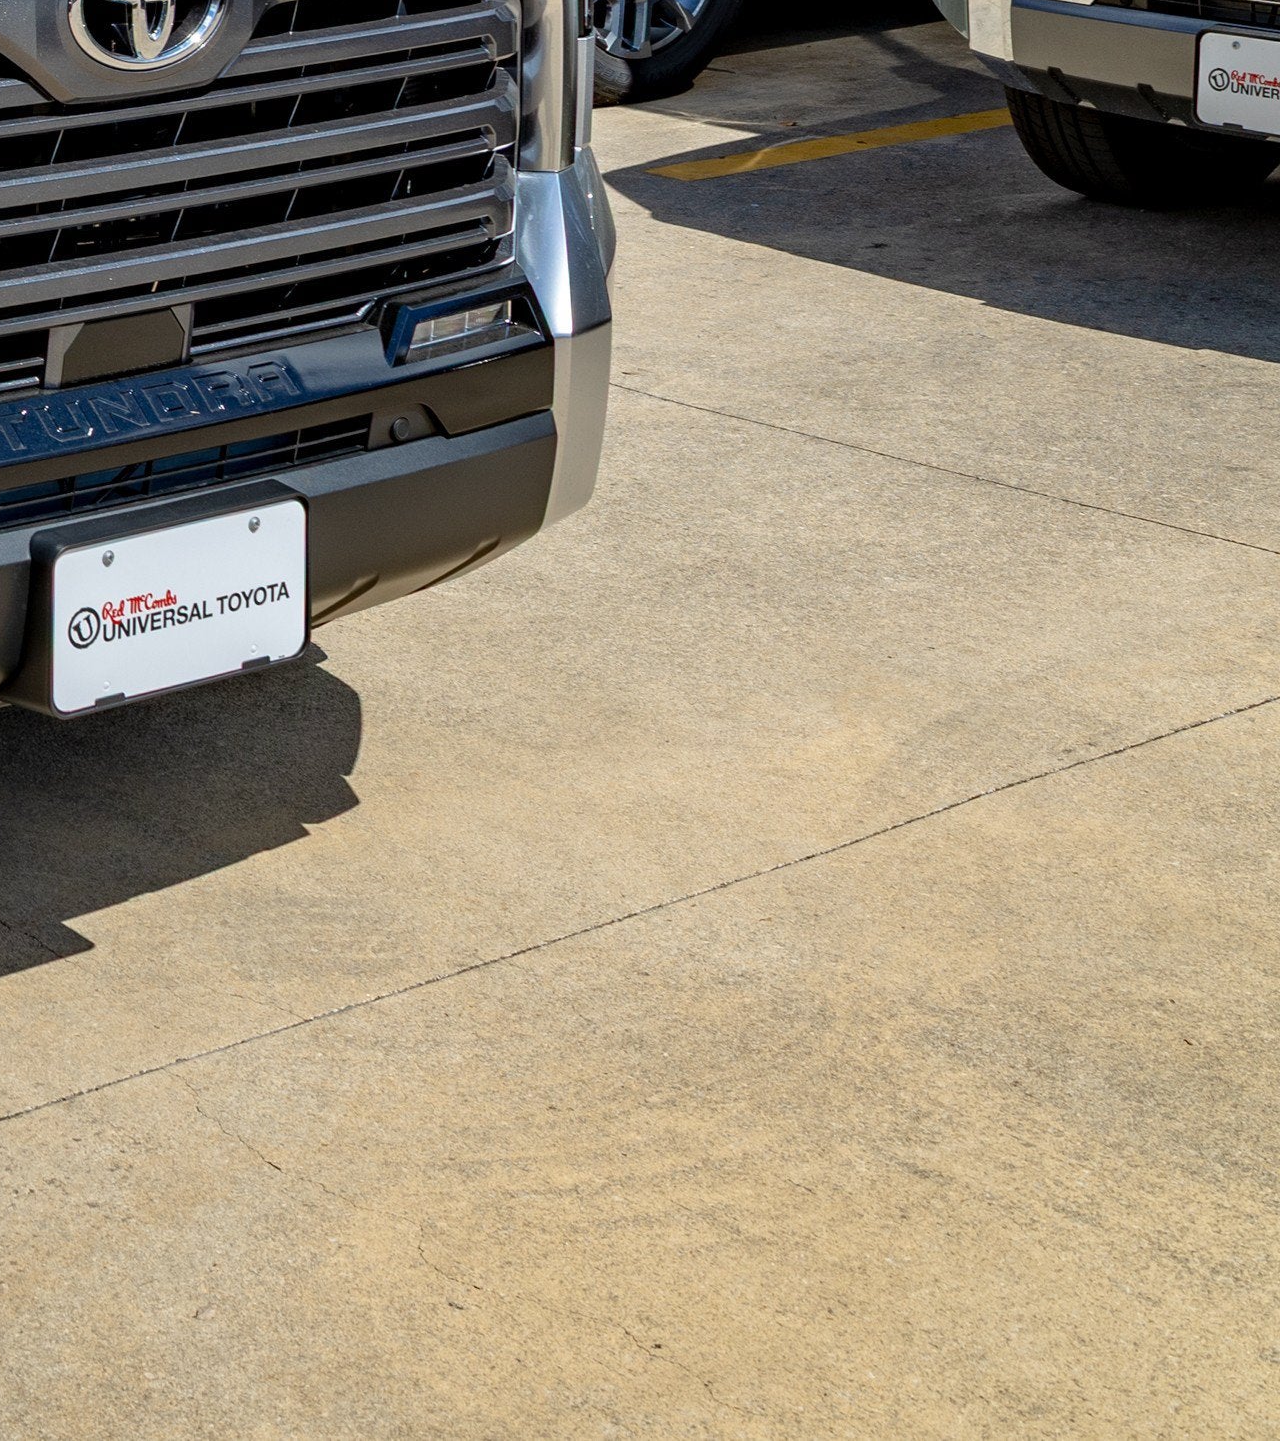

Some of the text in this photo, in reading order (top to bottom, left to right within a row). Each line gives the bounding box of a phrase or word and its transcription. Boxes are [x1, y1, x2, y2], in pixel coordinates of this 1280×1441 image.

[1231, 82, 1280, 100] UNIVER
[102, 589, 178, 625] Red McCombs
[102, 581, 290, 642] UNIVERSAL TOYOTA
